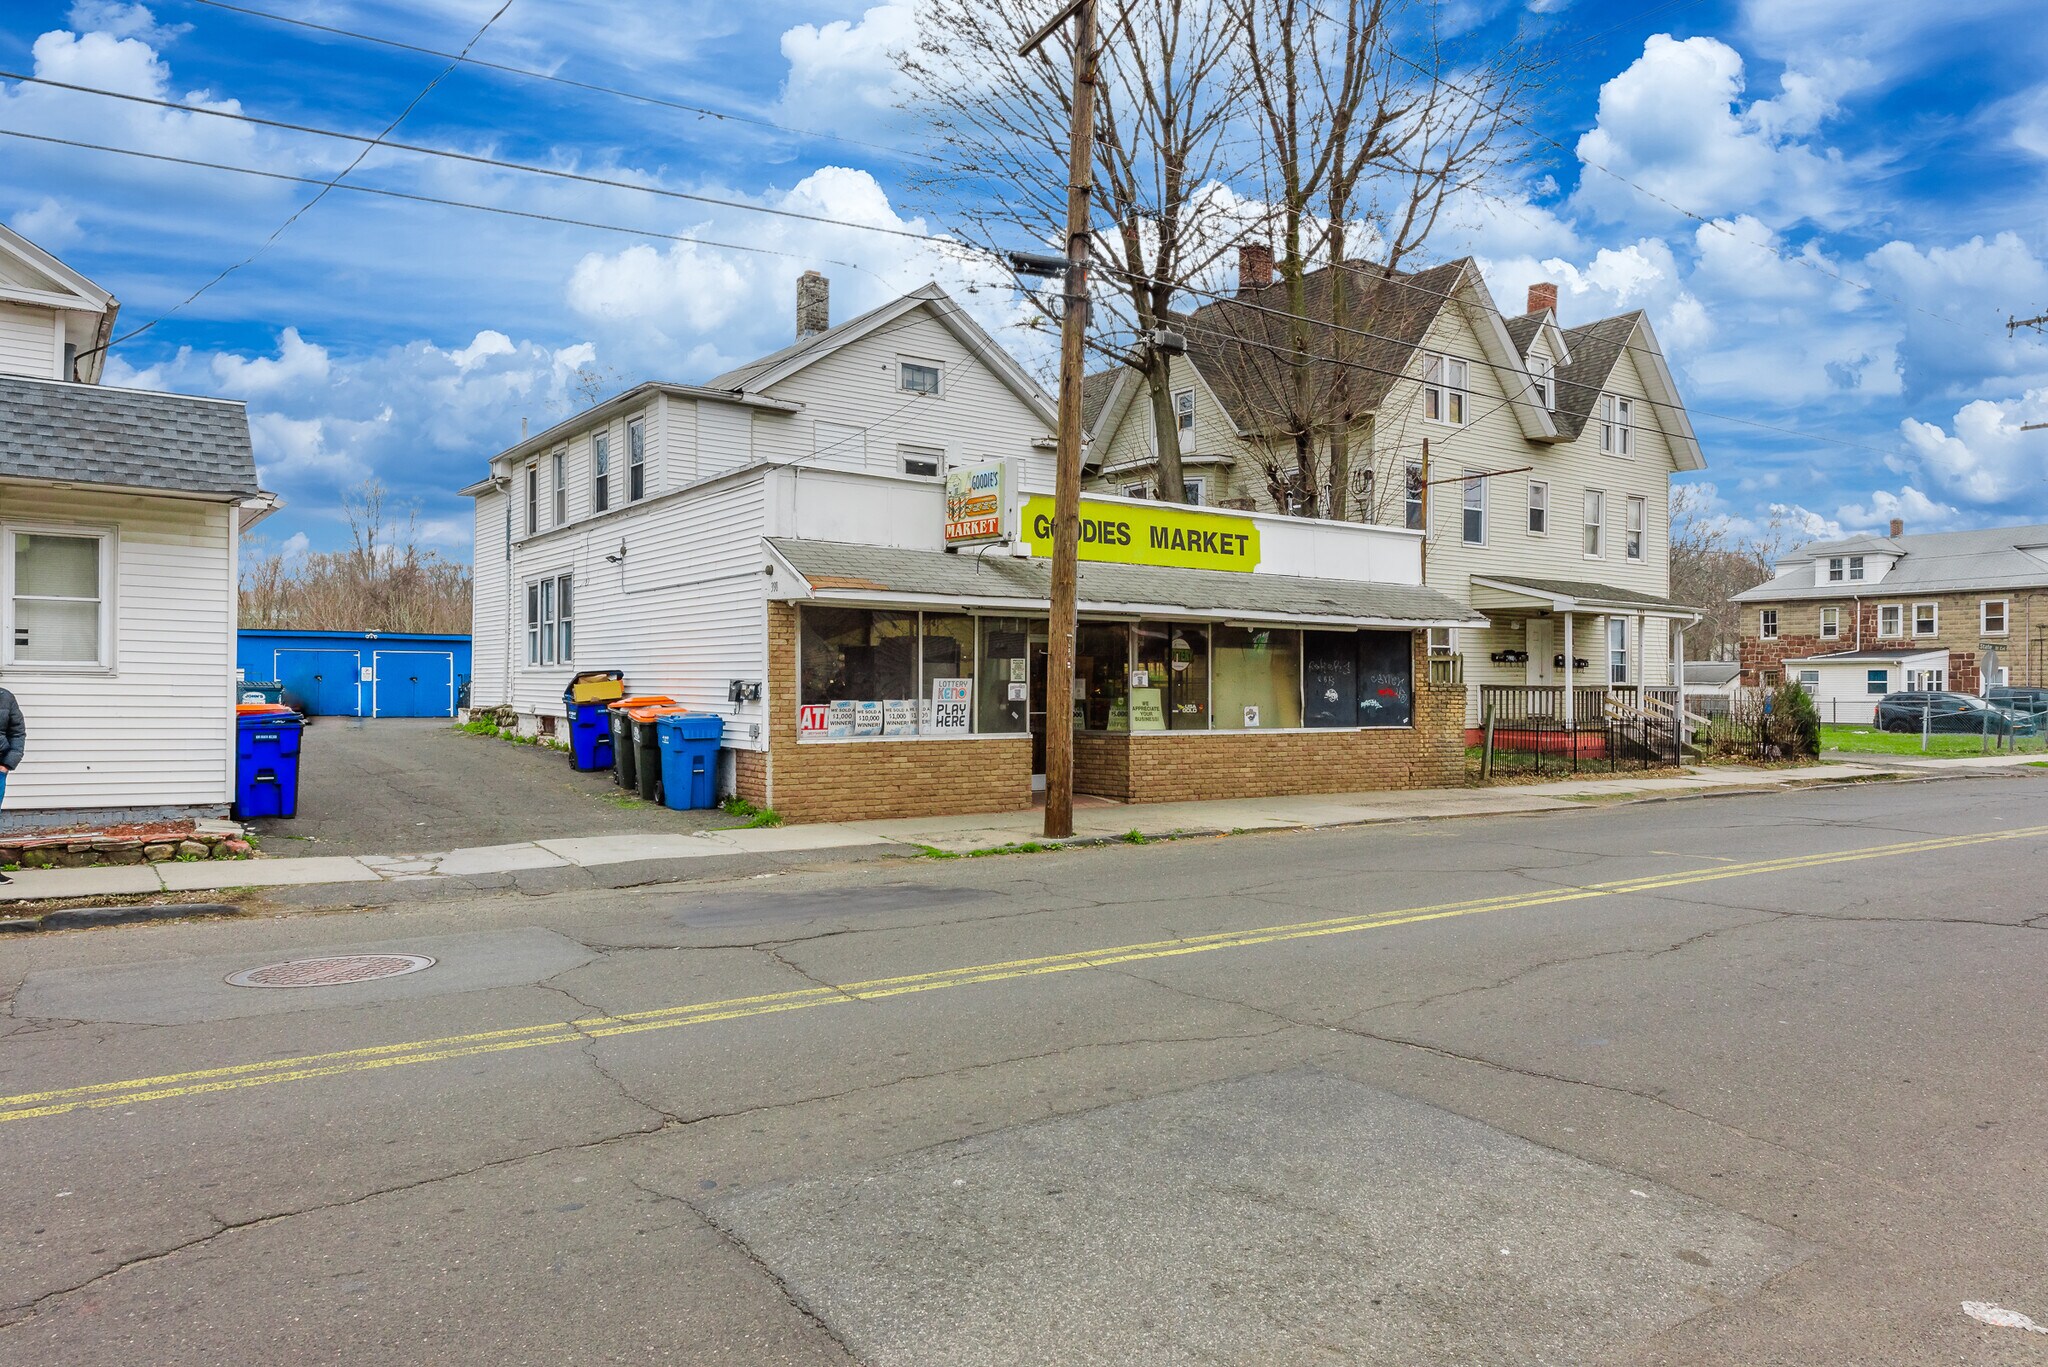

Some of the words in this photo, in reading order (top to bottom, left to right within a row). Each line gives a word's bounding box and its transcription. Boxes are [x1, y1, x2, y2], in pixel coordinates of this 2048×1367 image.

[971, 472, 998, 491] GOODIE'S
[946, 518, 996, 538] MARKET
[1034, 514, 1131, 546] GDIES
[1150, 525, 1249, 556] MARKET
[938, 680, 968, 688] LOTTERY
[936, 703, 966, 715] PLAY
[936, 715, 965, 727] HERE
